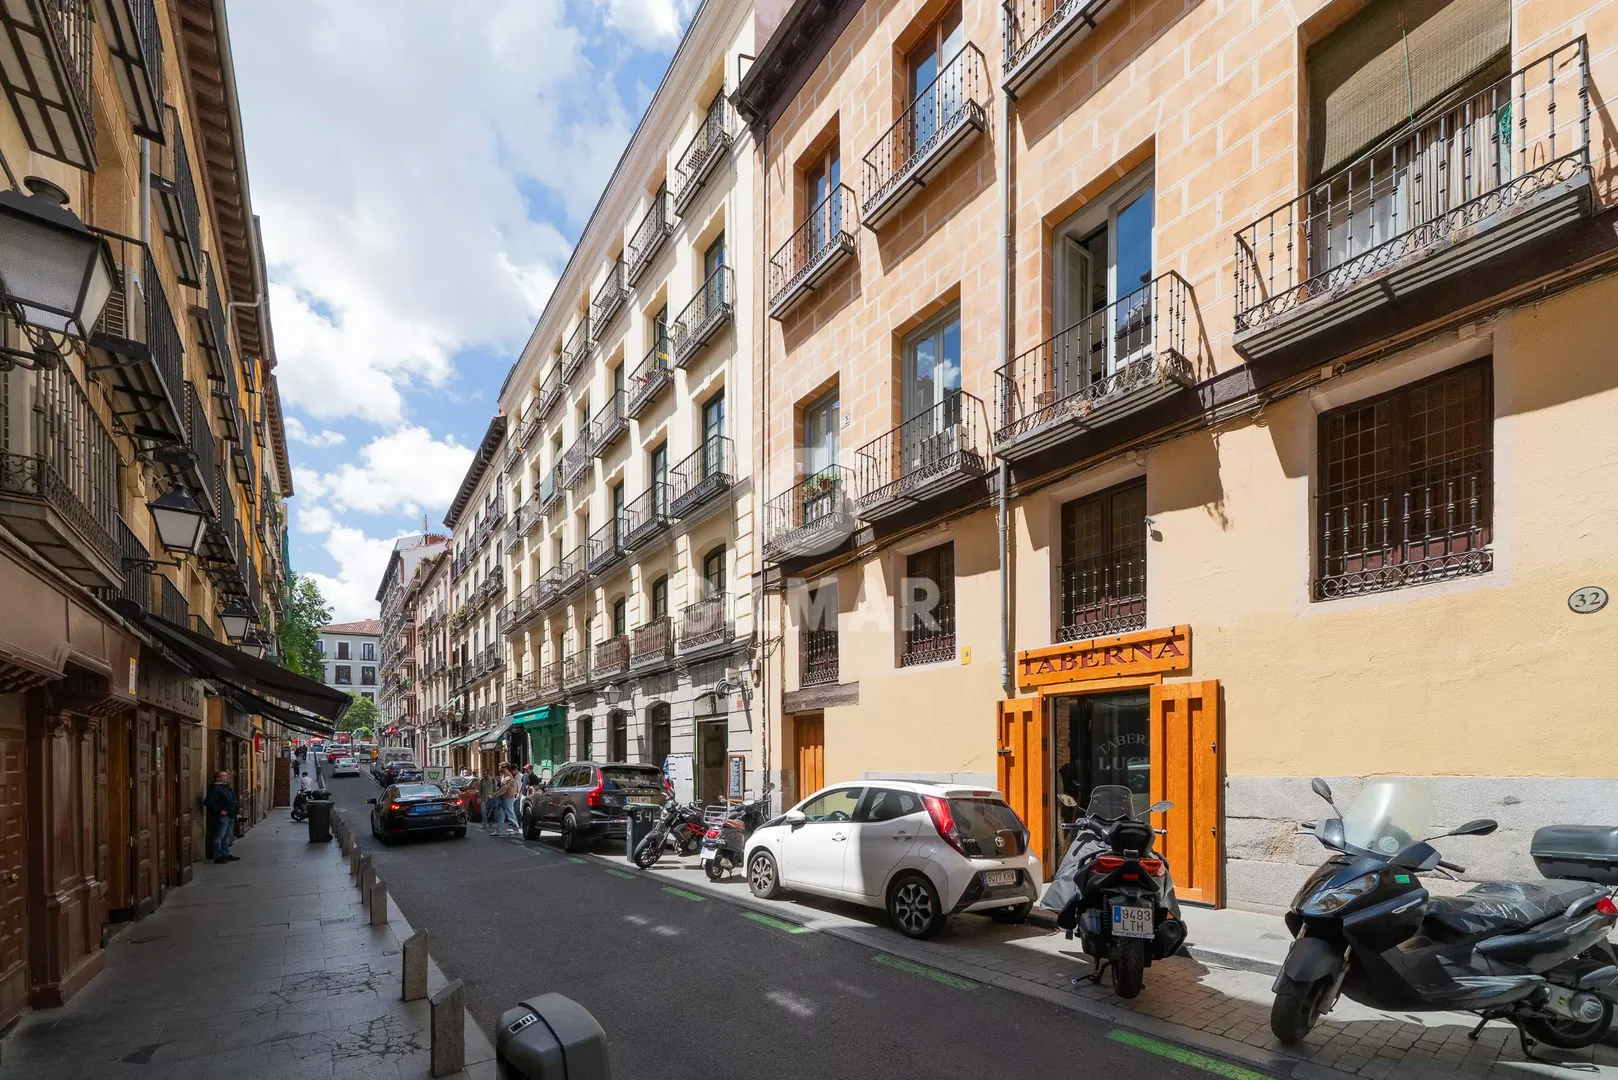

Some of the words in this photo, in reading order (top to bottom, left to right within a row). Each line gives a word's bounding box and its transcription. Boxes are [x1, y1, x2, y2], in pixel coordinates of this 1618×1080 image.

[1575, 591, 1601, 608] 32
[1019, 638, 1185, 676] TABERNA
[1096, 733, 1150, 754] TABER
[986, 872, 1002, 883] 9077
[1122, 908, 1151, 922] 9493
[1122, 920, 1144, 933] LTH
